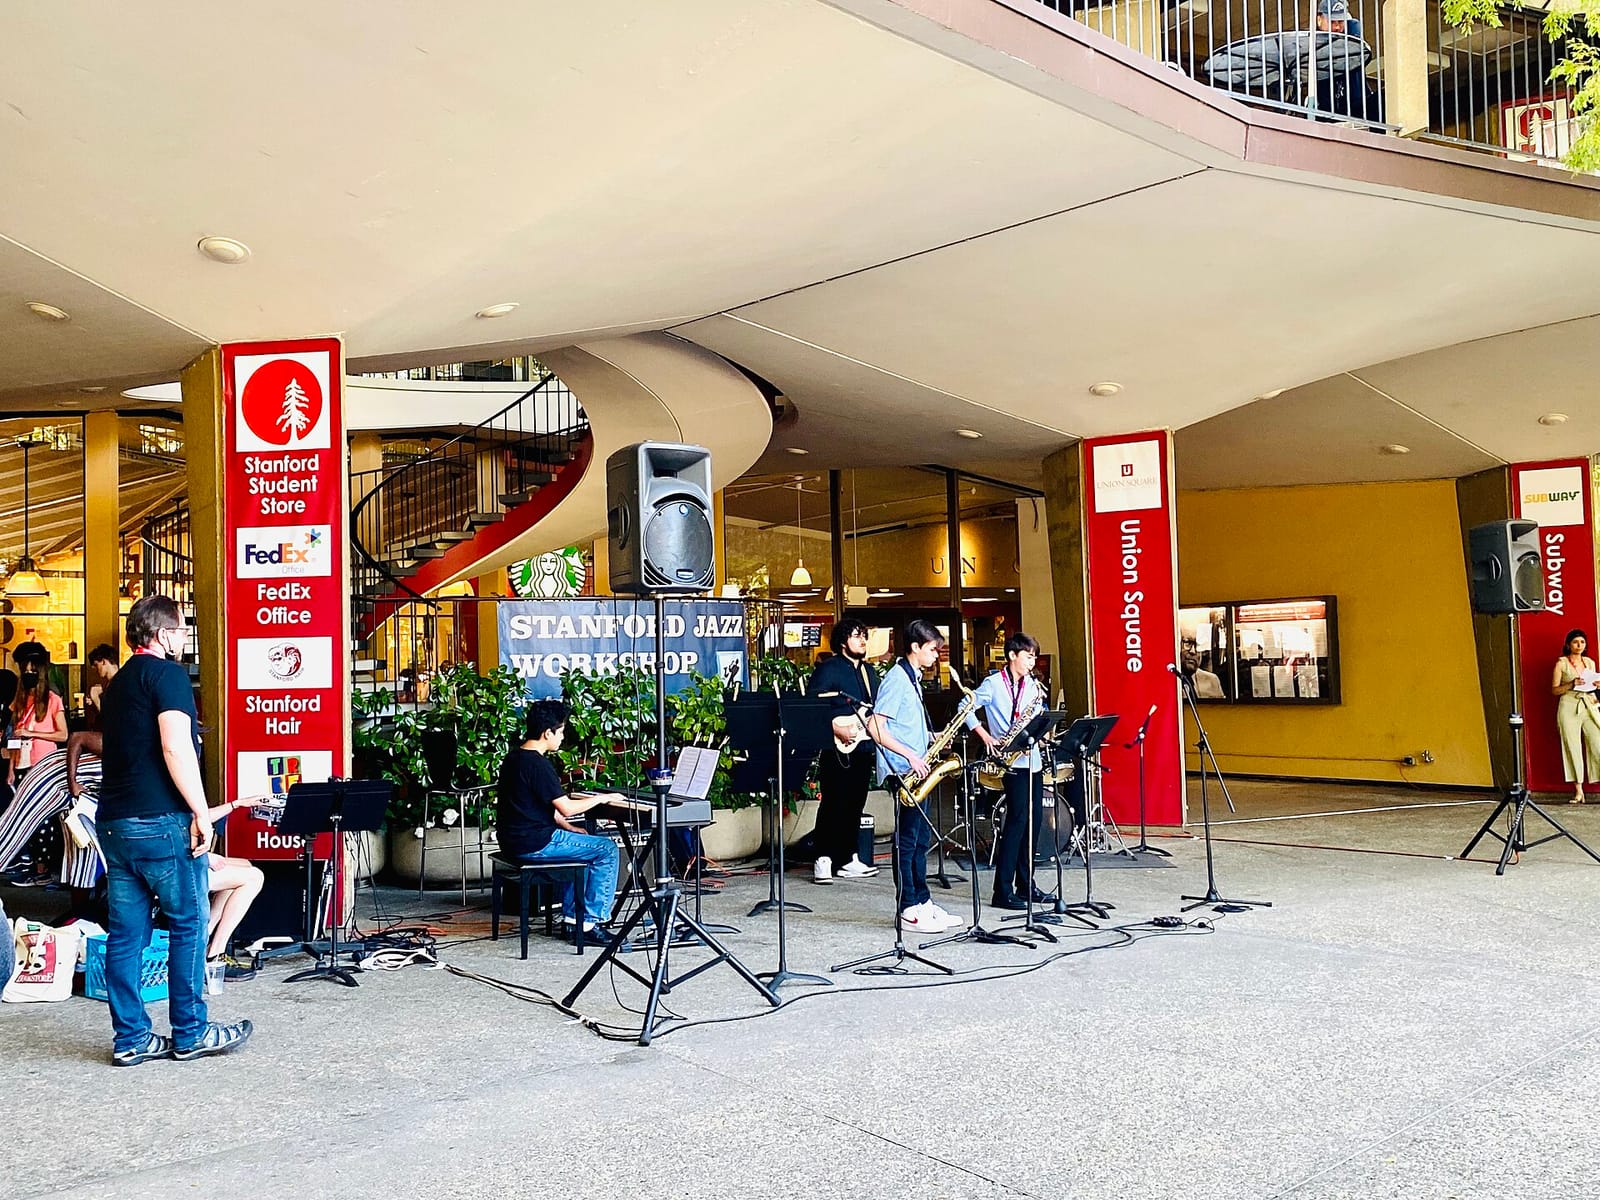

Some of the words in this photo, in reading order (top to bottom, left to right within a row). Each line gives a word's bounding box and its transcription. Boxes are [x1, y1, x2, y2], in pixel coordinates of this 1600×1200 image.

[244, 453, 319, 474] Stanford
[1122, 464, 1132, 476] U
[249, 475, 318, 495] Student
[261, 497, 306, 514] Store
[1524, 491, 1580, 504] SUBWAY
[245, 543, 309, 565] FedEx
[1120, 519, 1142, 584] Union
[281, 565, 305, 574] Office
[1545, 533, 1566, 616] Subway
[257, 582, 312, 601] FedEx
[256, 606, 312, 625] Office
[693, 615, 743, 638] JAZZ
[1120, 590, 1144, 673] Square
[510, 651, 698, 679] WORKSHOP
[245, 694, 321, 714] Stanford
[265, 716, 302, 735] Hair
